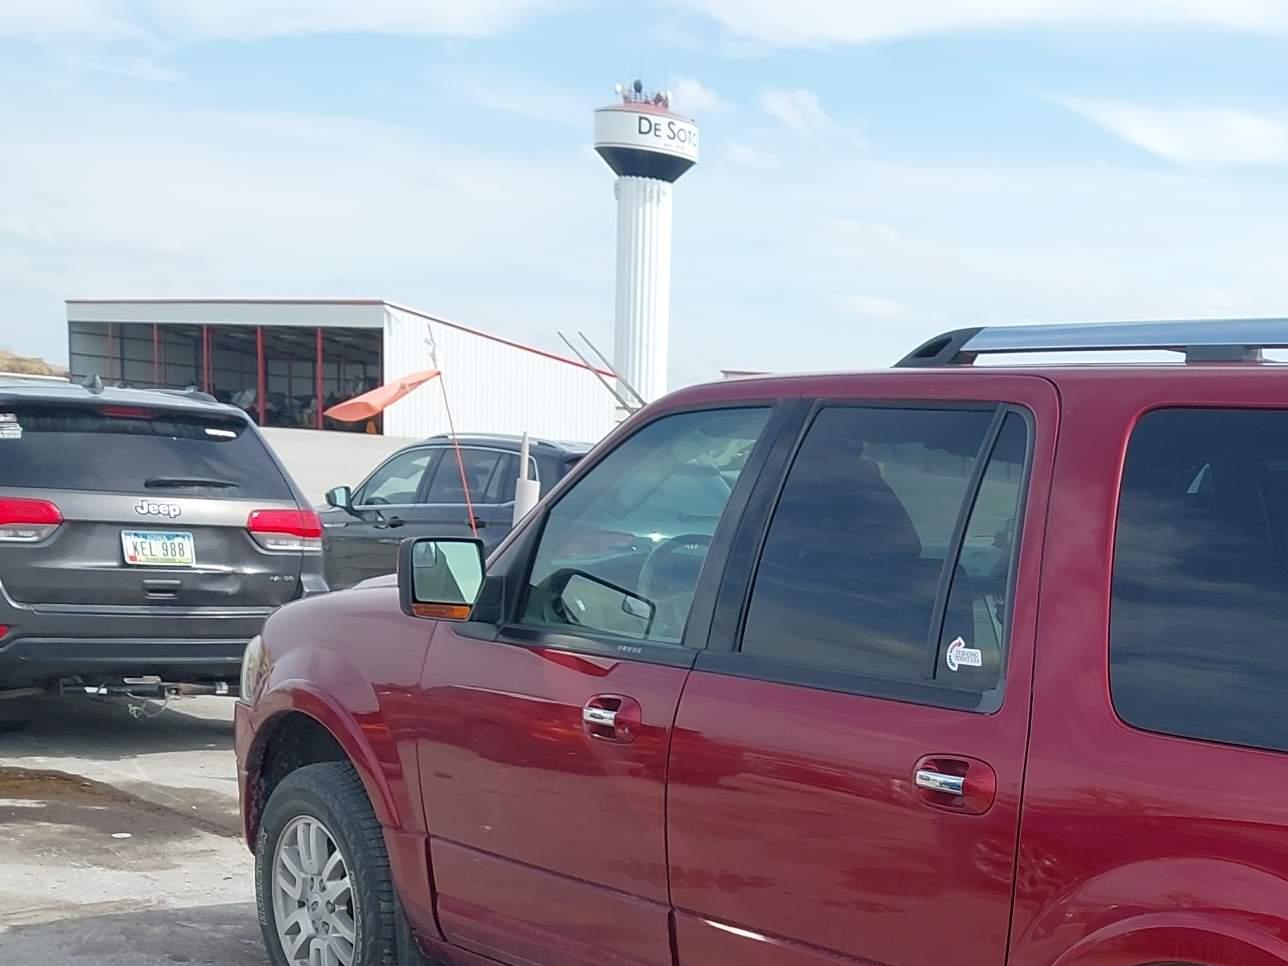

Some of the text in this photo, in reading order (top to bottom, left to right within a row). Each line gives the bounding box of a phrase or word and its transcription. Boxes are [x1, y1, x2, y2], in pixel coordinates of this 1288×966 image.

[134, 499, 182, 519] Jeep
[132, 540, 186, 558] KEL 988
